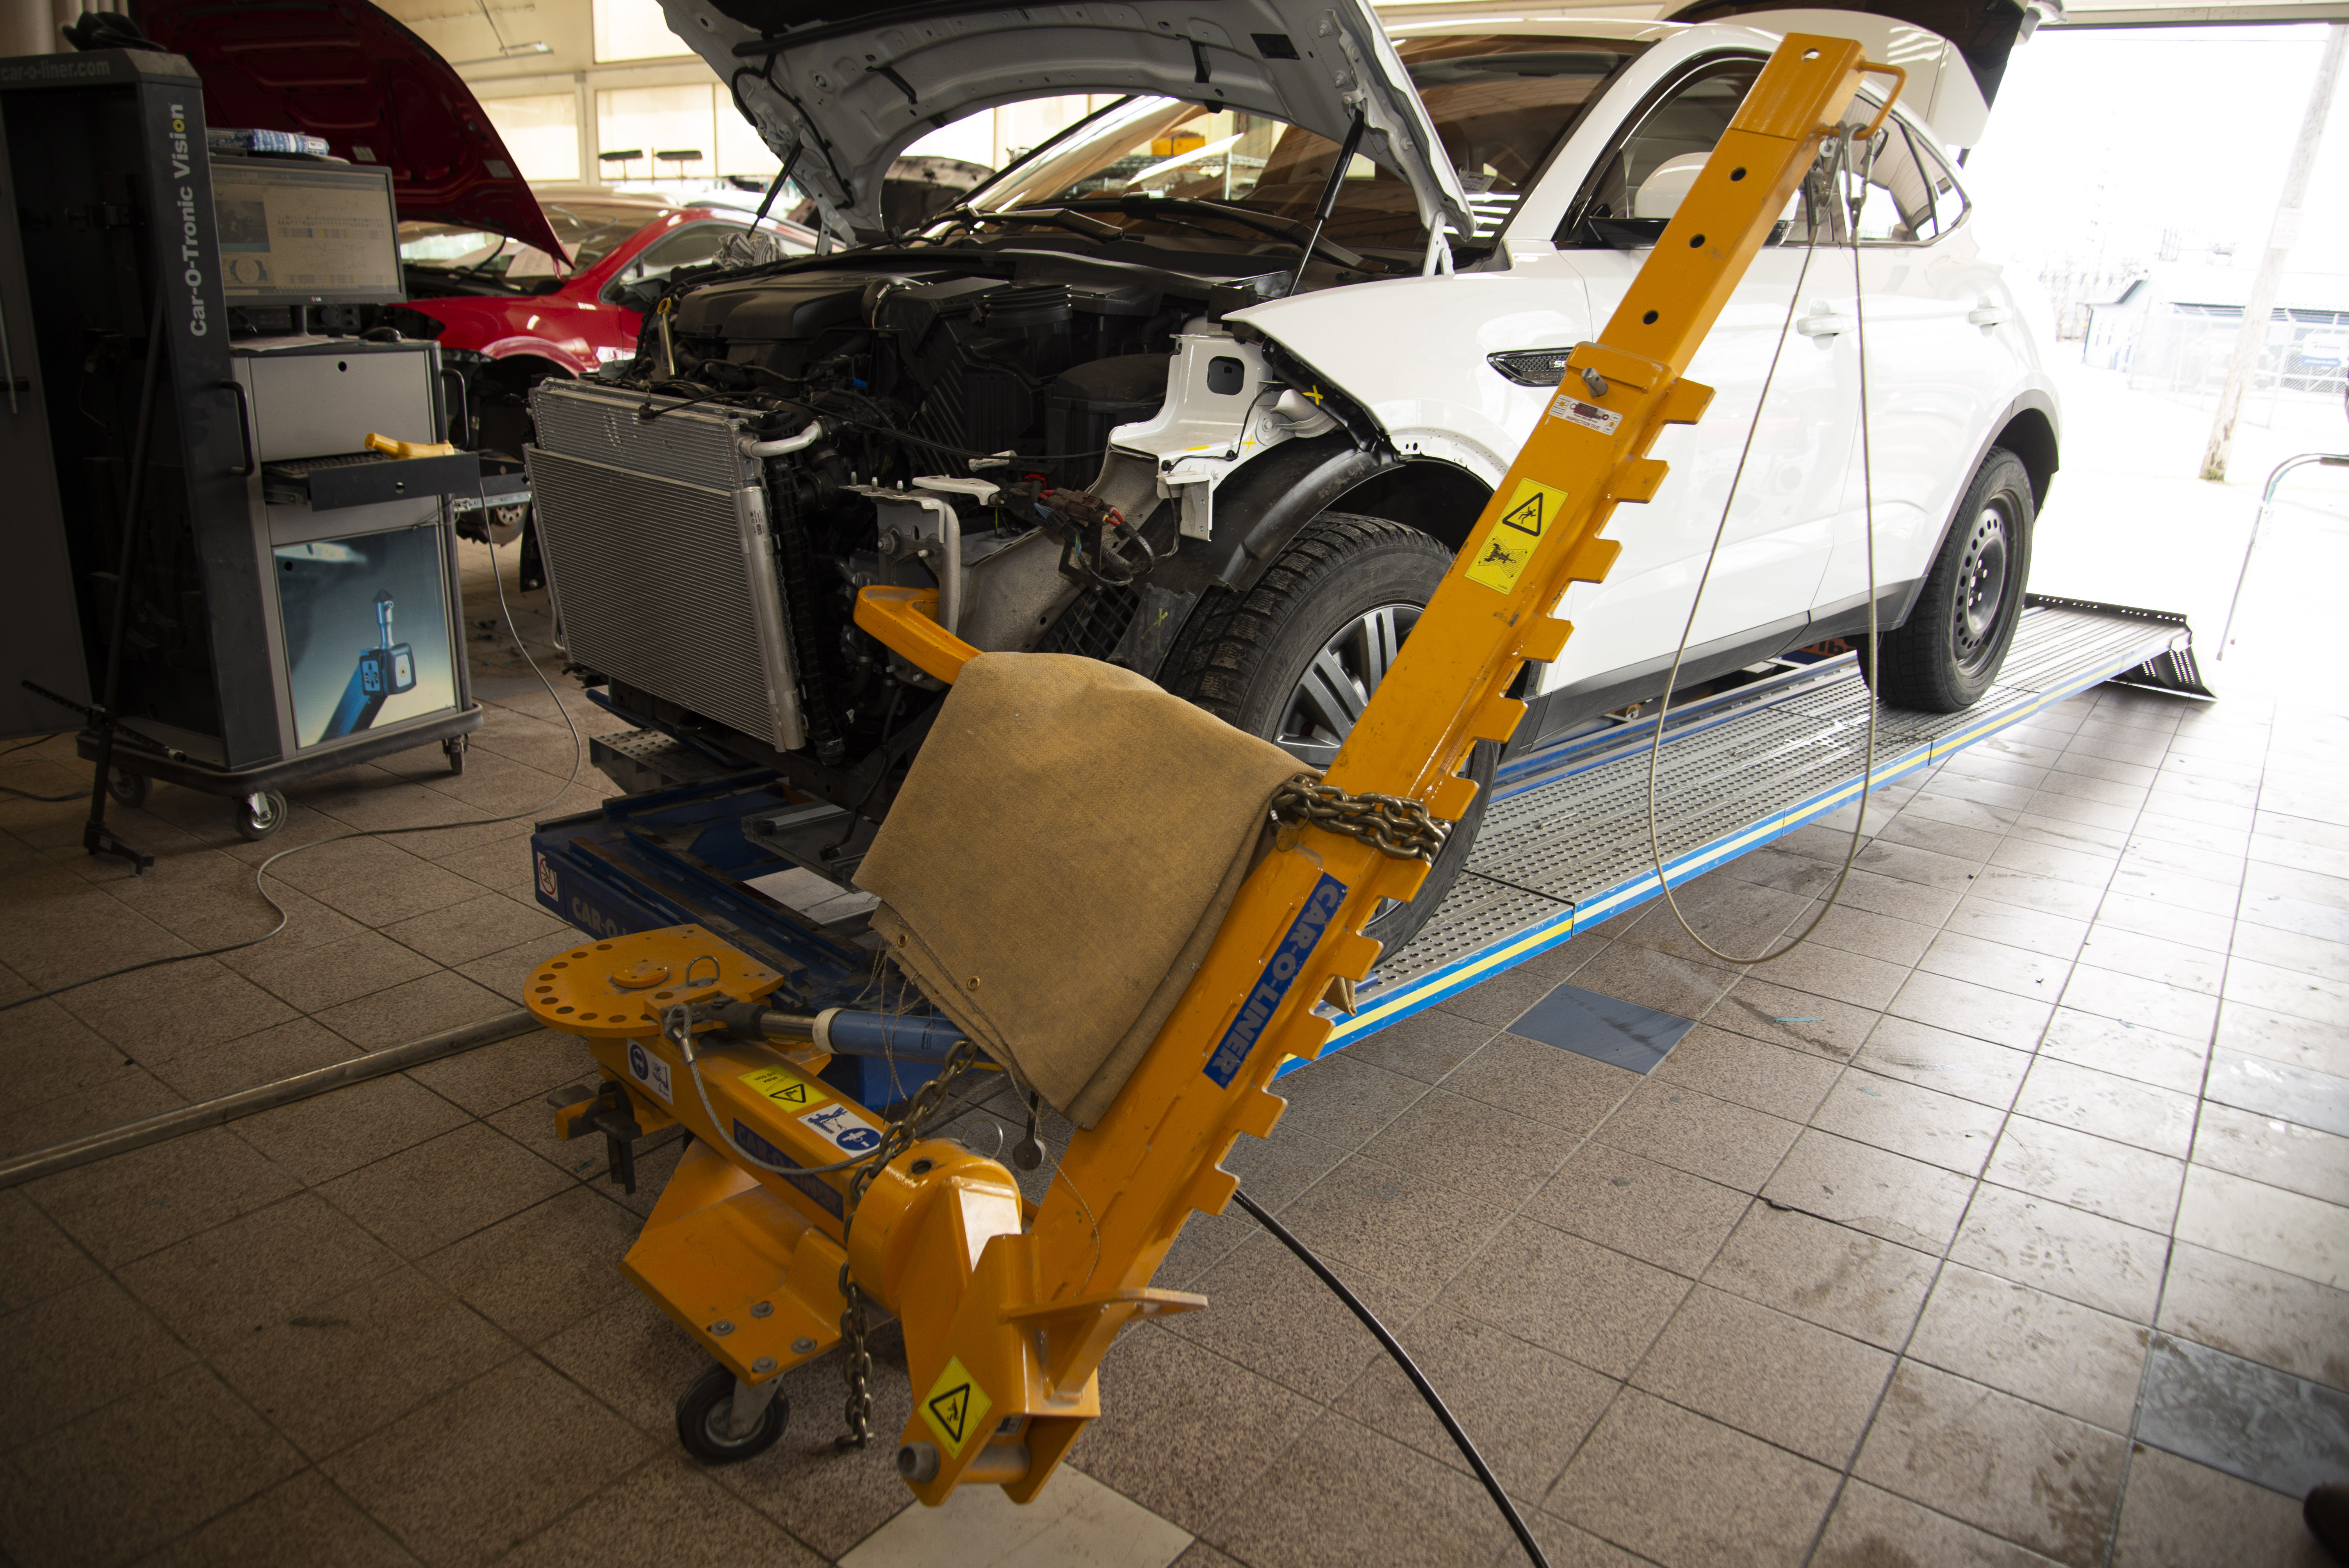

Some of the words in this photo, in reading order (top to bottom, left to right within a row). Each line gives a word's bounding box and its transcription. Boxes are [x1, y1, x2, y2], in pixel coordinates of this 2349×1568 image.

[169, 104, 190, 179] Vision
[177, 186, 207, 337] Car-O-Tronic
[1565, 415, 1590, 427] INSPECTION
[1212, 884, 1338, 1075] CAR-O-LINER
